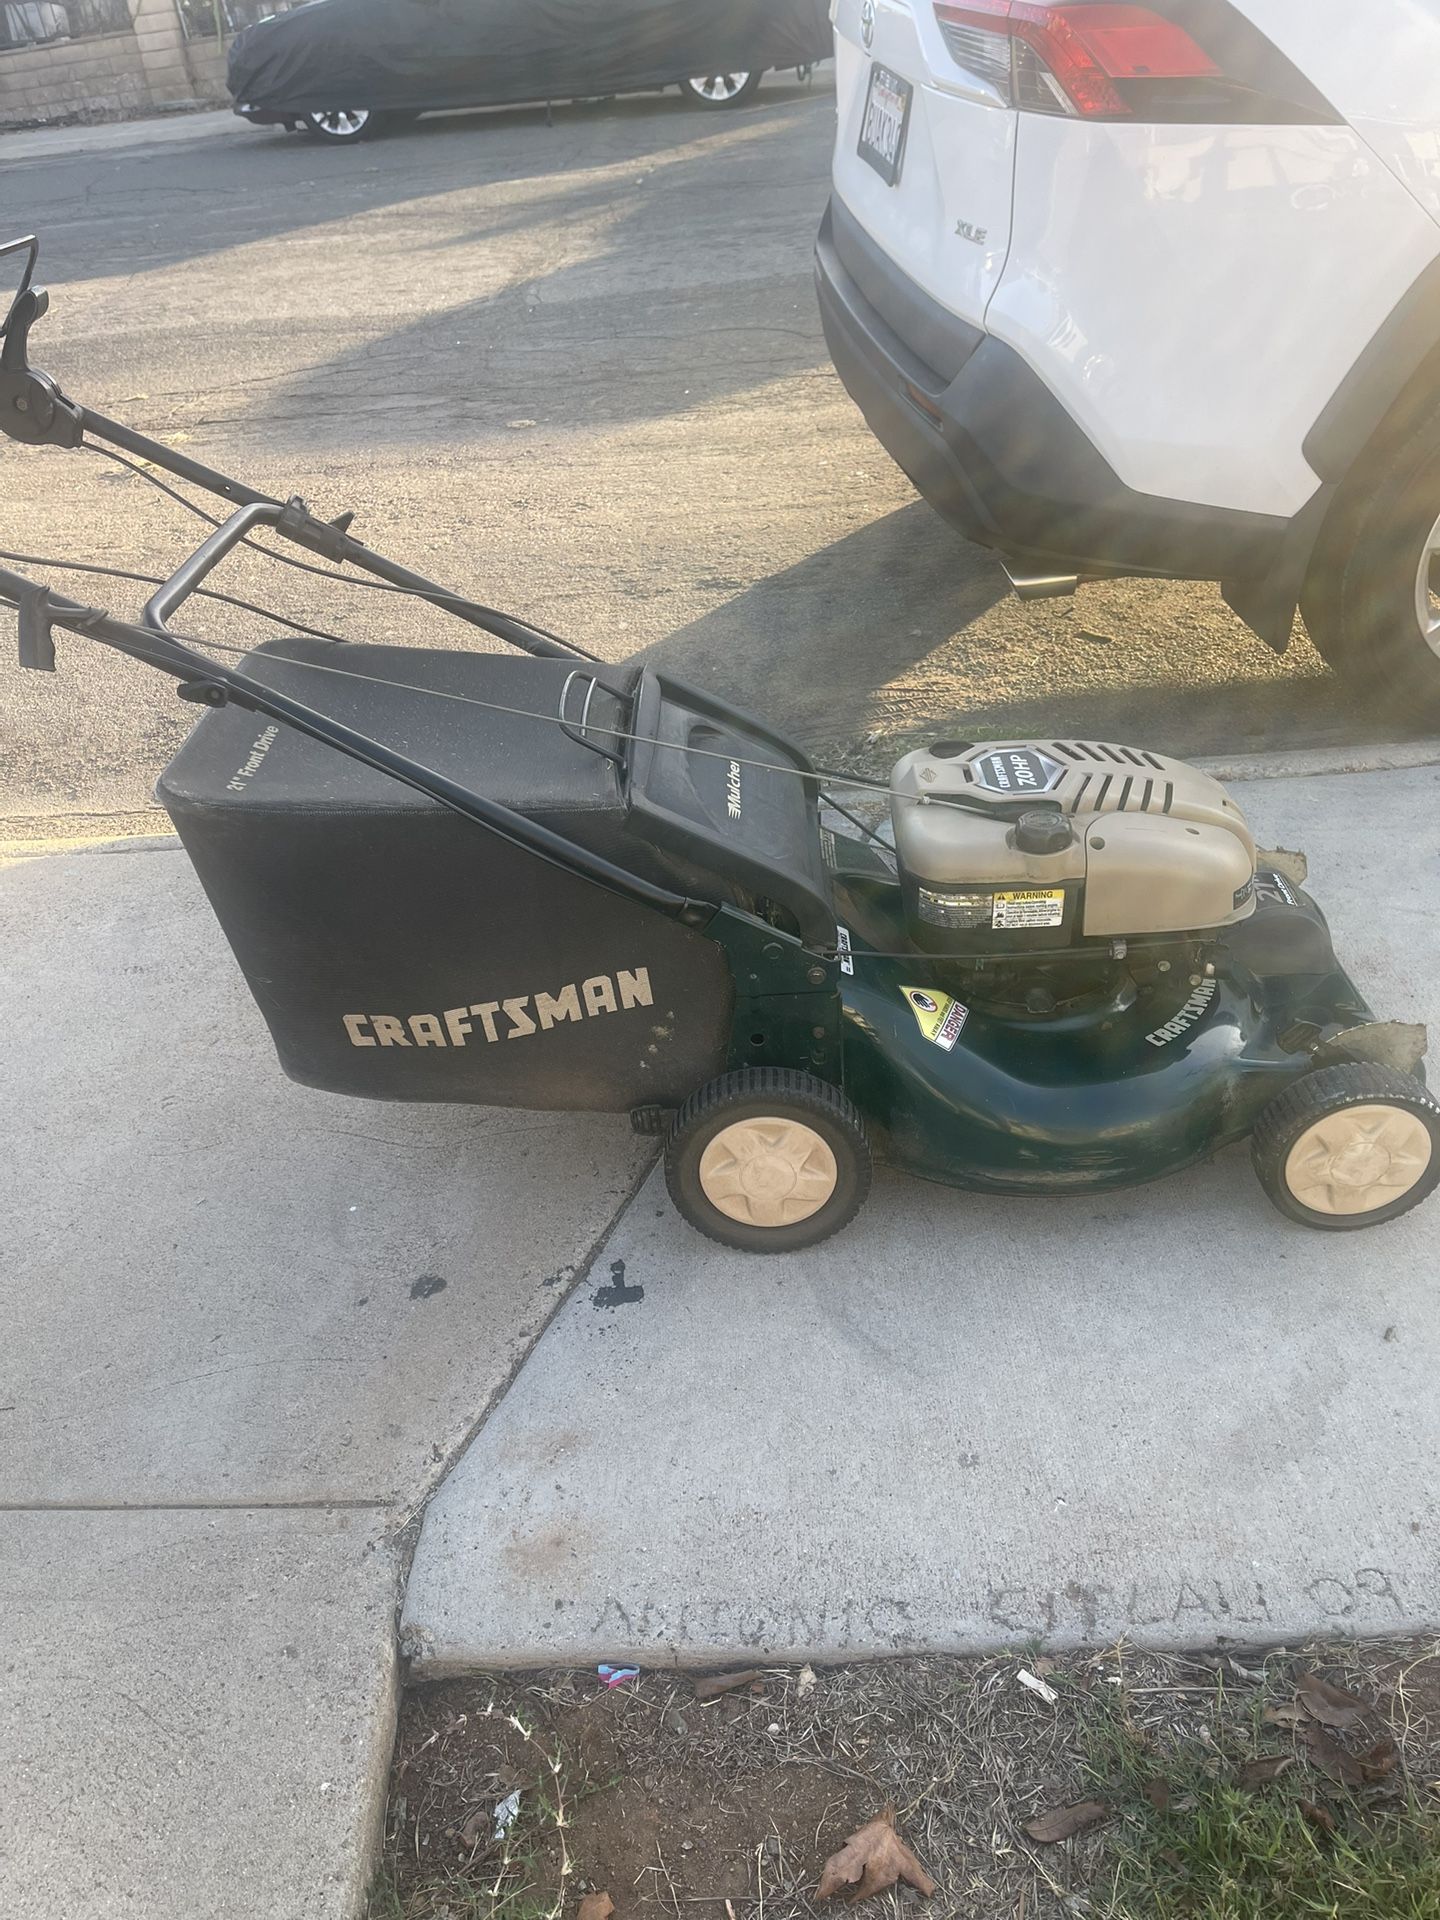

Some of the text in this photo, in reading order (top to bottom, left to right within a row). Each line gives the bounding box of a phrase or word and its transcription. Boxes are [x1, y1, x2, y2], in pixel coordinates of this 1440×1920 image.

[955, 219, 987, 246] XLE
[237, 751, 265, 777] Front
[252, 725, 279, 752] Drive
[990, 756, 1011, 788] CRAFTSMAN
[1012, 890, 1054, 900] WARNING
[342, 967, 654, 1047] CRAFTSMAN
[940, 1003, 966, 1041] DANGER
[1145, 978, 1217, 1047] CRAFTSMAN
